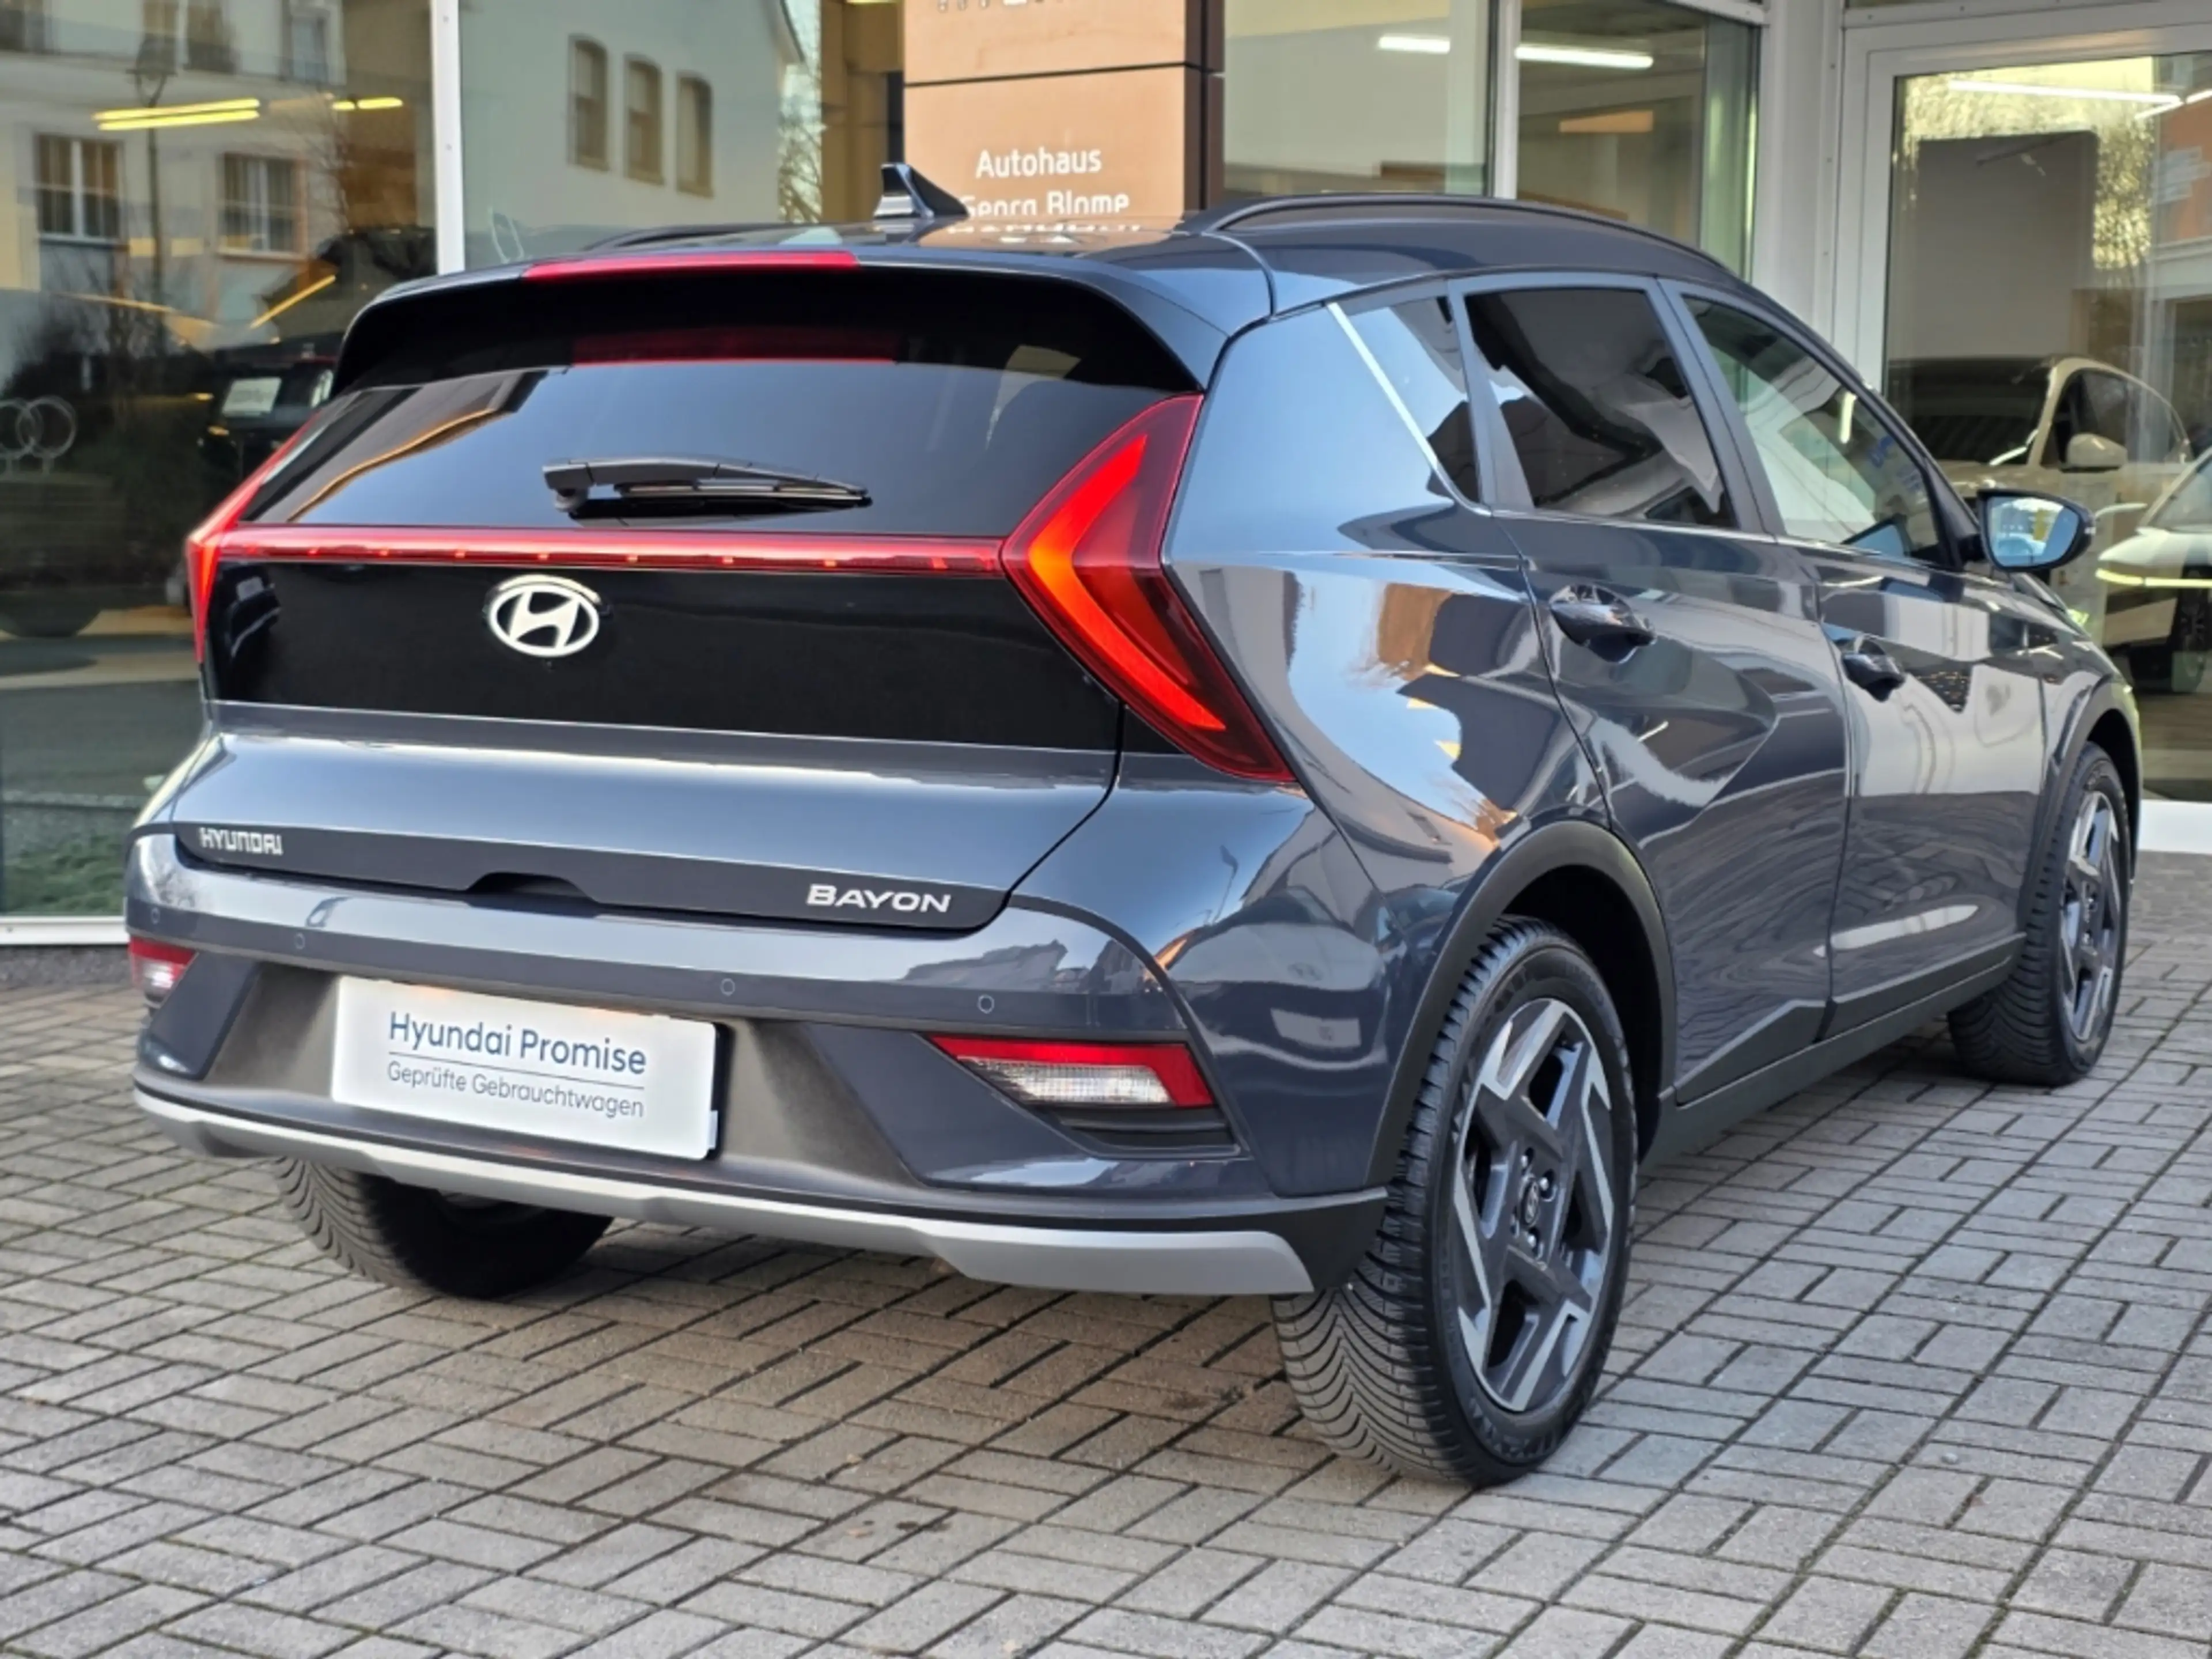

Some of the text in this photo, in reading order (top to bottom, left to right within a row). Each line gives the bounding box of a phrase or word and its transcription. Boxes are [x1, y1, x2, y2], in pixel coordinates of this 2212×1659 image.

[976, 146, 1102, 179] Autohaus
[199, 827, 283, 855] HYUNDAI
[806, 884, 951, 912] BAYON
[389, 1011, 646, 1074] Hyundai Promise
[388, 1060, 644, 1118] Geprüfte Gebrauchtwagen
